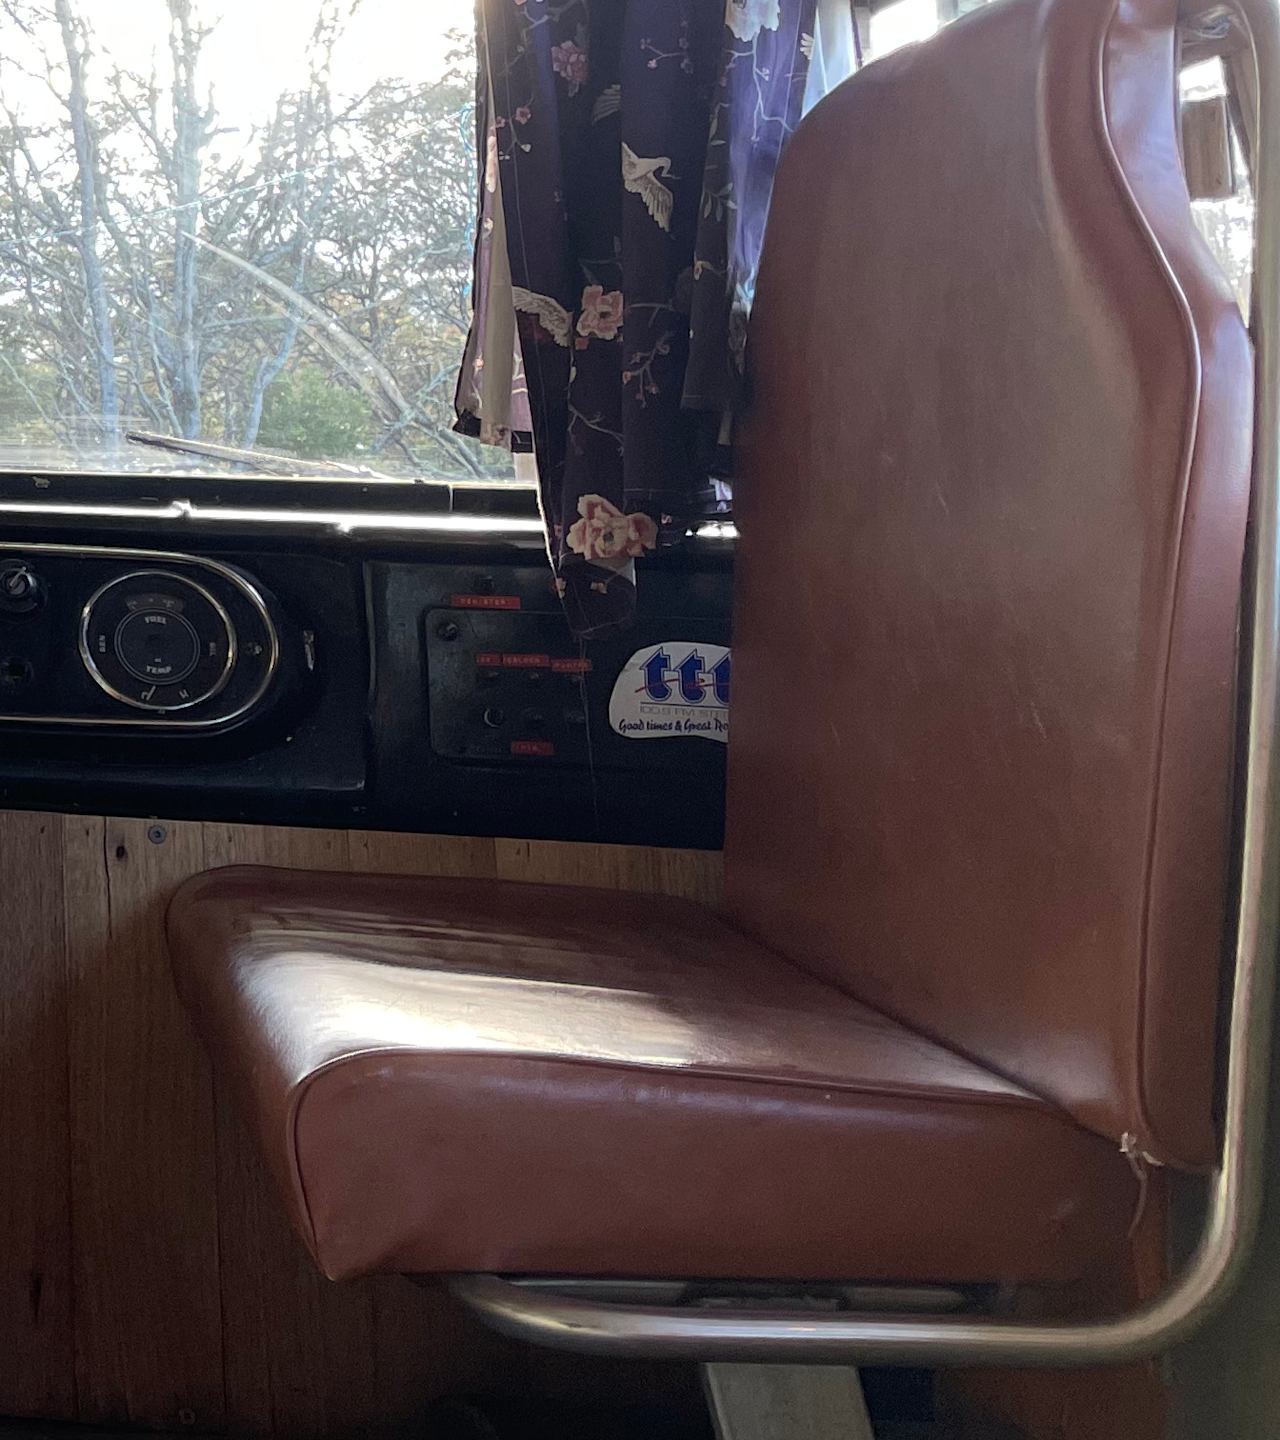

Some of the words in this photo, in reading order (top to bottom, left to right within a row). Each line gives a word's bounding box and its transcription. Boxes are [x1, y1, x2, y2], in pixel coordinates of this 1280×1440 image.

[144, 615, 167, 625] FUEL
[145, 665, 172, 674] TEMP
[619, 718, 645, 734] Good
[646, 719, 673, 731] times
[683, 718, 712, 734] Great
